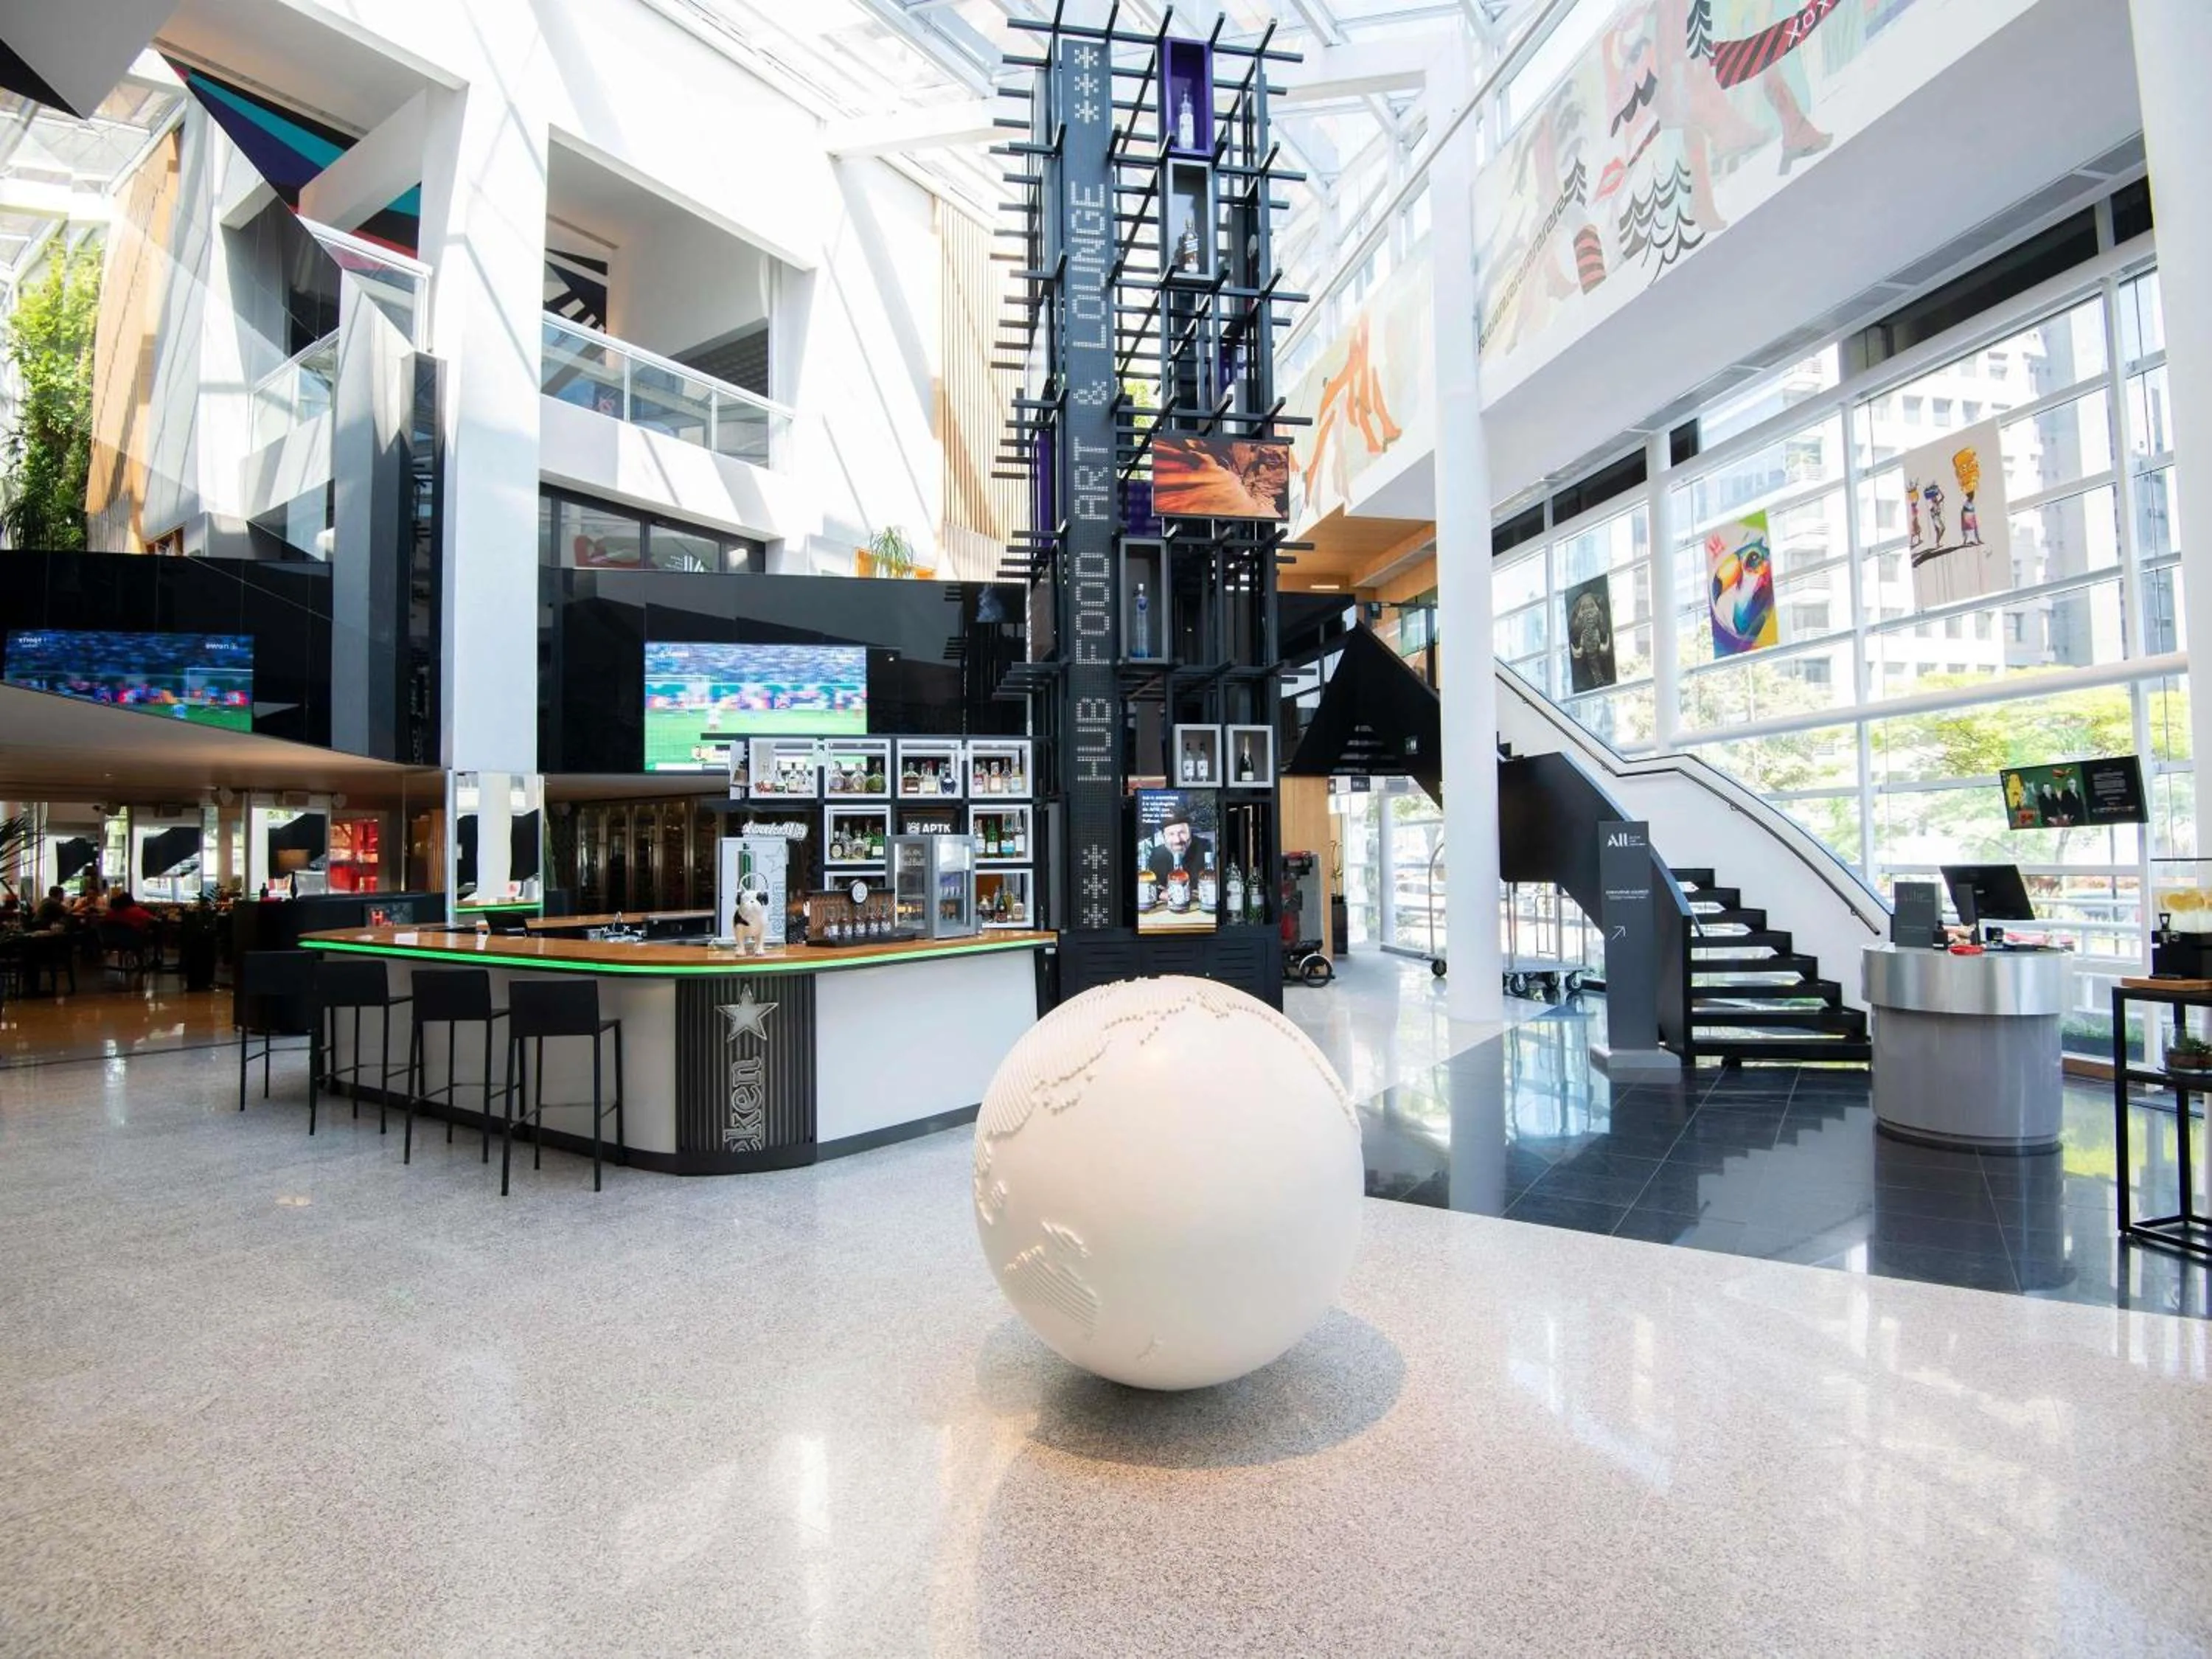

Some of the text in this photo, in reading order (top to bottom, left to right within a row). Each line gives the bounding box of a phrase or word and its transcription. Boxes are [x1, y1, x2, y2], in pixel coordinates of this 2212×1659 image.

[1071, 181, 1111, 782] HUB FOOD ART & LOUNGE
[922, 823, 951, 833] APTK
[1607, 832, 1628, 847] All
